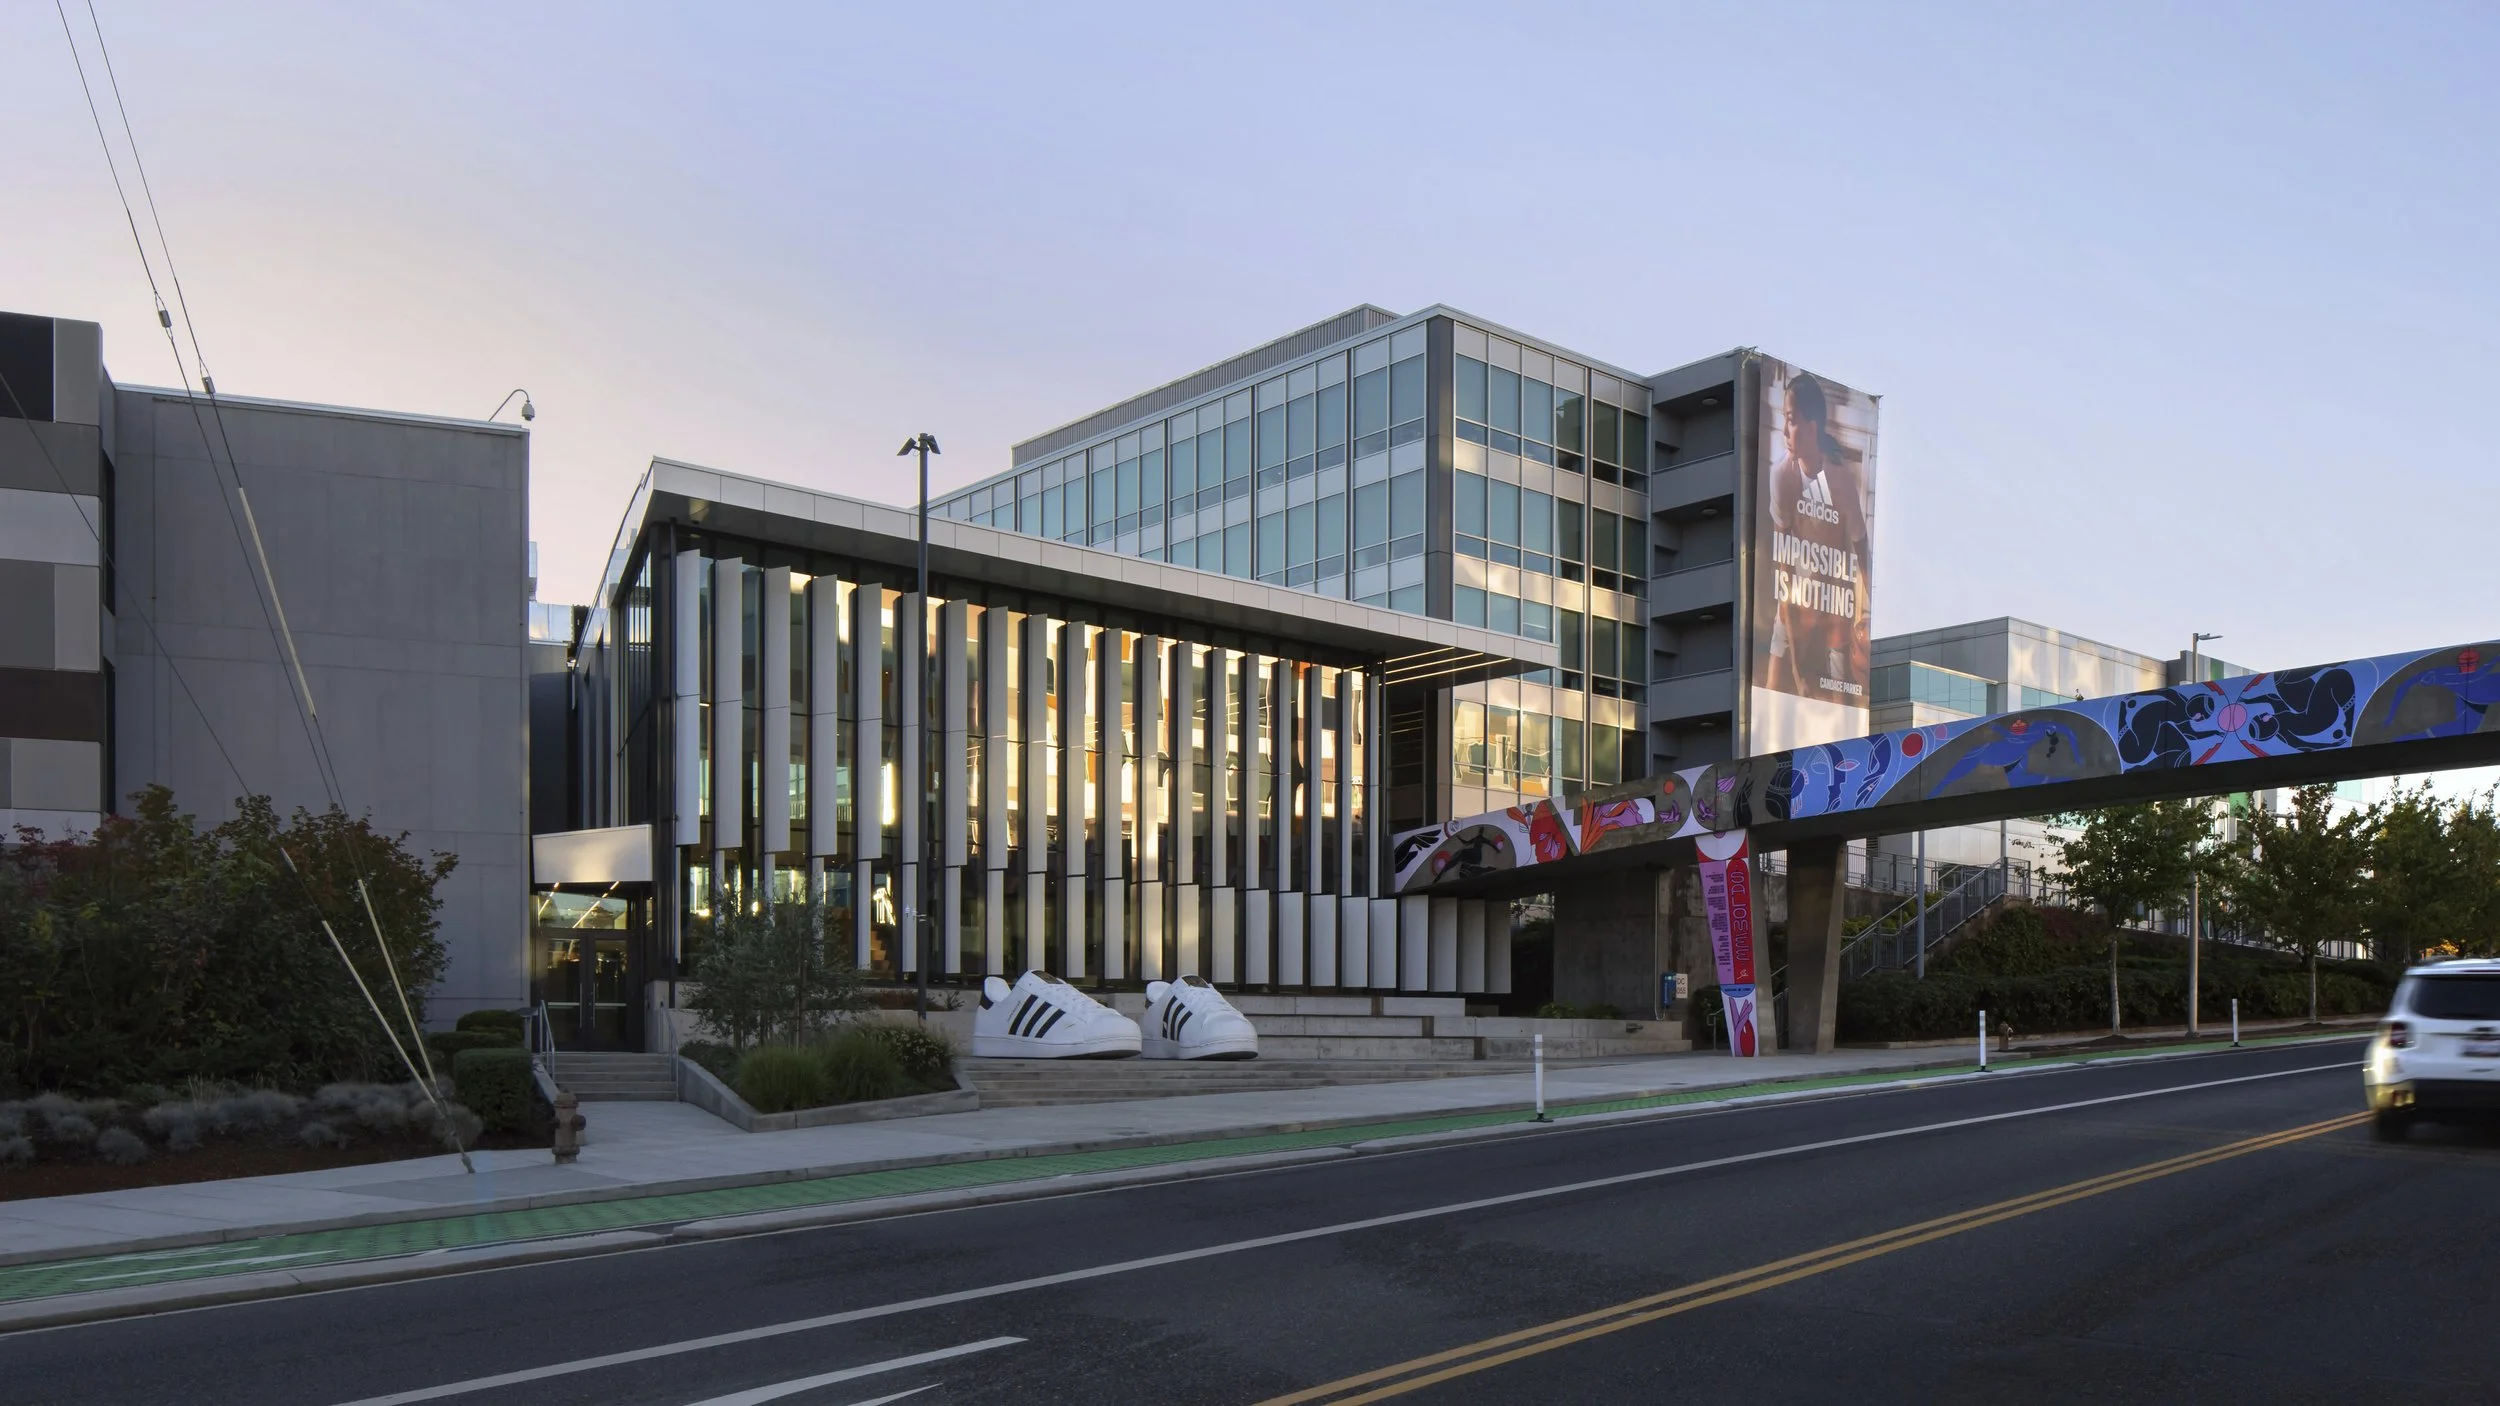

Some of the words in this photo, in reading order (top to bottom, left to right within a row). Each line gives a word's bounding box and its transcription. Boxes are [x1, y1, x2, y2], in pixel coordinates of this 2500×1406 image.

[1797, 499, 1839, 525] adidas
[1773, 531, 1858, 583] IMPOSSIBLE
[1774, 569, 1789, 602] IS
[1791, 575, 1854, 619] NOTHING
[1820, 677, 1843, 692] CANDACE
[1843, 682, 1863, 696] PARKER
